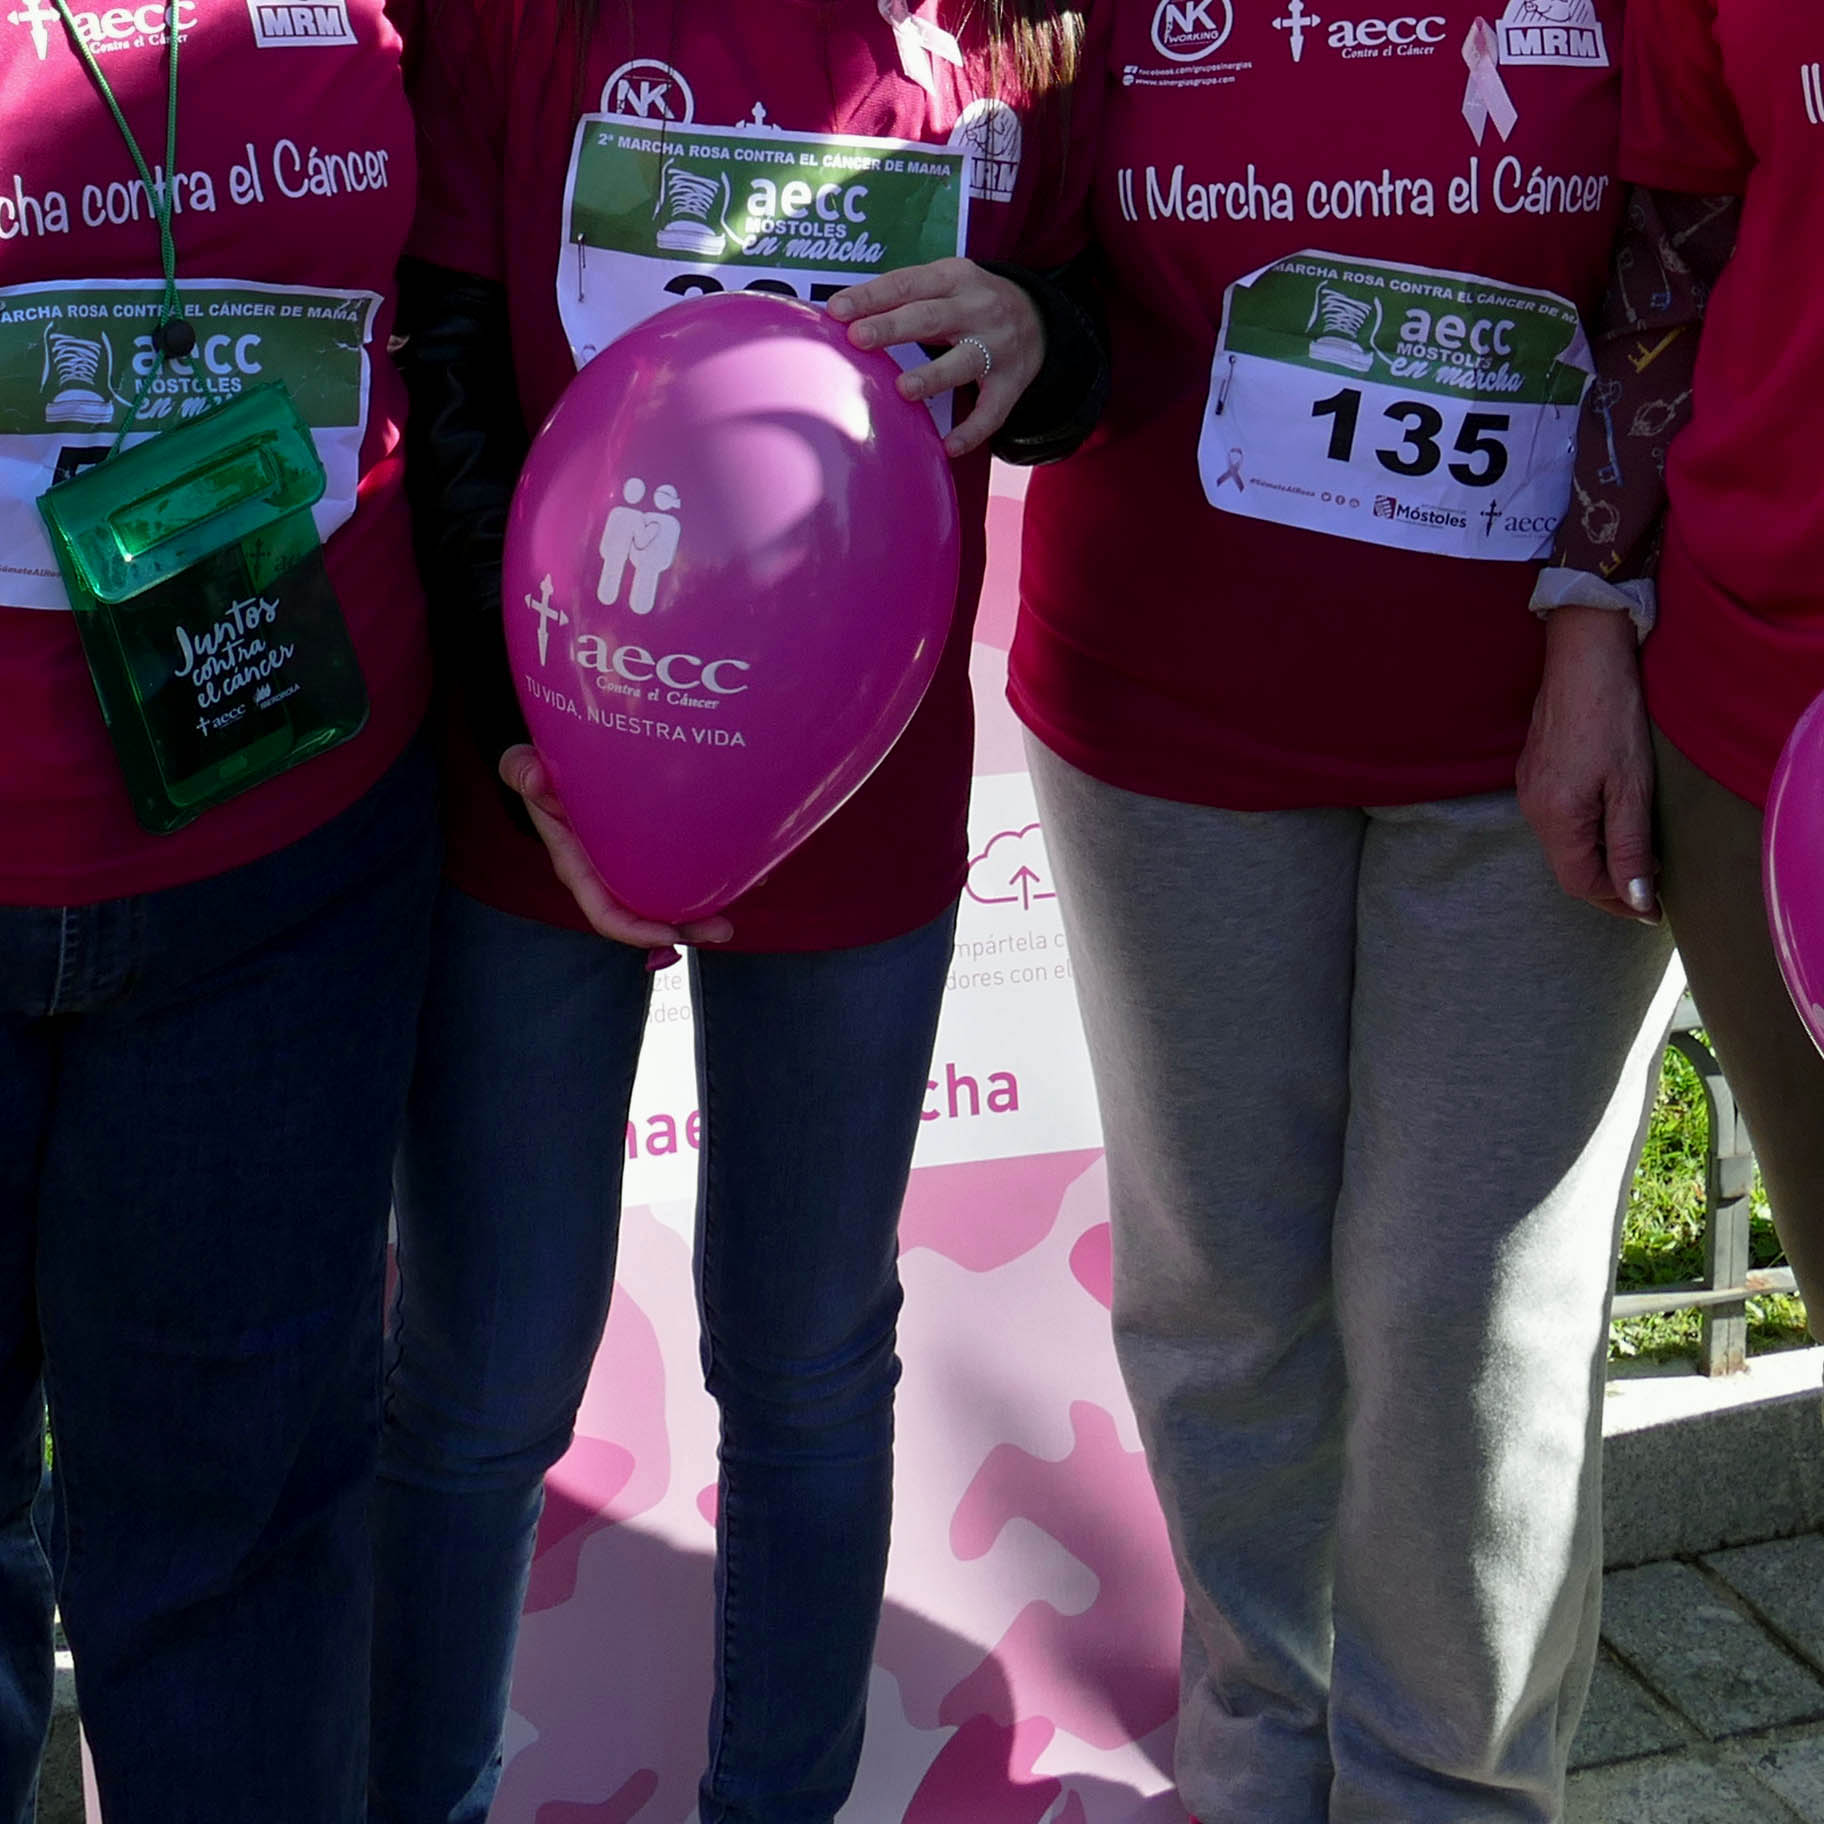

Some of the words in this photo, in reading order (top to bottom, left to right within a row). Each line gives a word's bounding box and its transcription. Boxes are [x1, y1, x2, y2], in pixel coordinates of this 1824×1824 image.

[73, 0, 199, 43] aecc
[259, 3, 344, 39] MRM
[1327, 15, 1447, 50] aecc
[1341, 44, 1380, 60] Contra
[1382, 44, 1394, 58] el
[1396, 43, 1436, 58] Cáncer
[1508, 27, 1599, 58] MRM
[617, 136, 685, 156] MARCHA
[688, 144, 730, 161] ROSA
[733, 147, 795, 166] CONTRA
[798, 152, 819, 167] EL
[822, 151, 881, 172] CÁNCER
[883, 158, 905, 173] DE
[907, 160, 952, 177] MAMA
[81, 163, 217, 228] contra
[229, 141, 264, 206] el
[272, 137, 390, 199] Cáncer
[746, 177, 868, 223] aecc
[1144, 162, 1294, 223] Marcha
[1306, 168, 1435, 222] contra
[1447, 155, 1480, 215] el
[1491, 154, 1610, 214] Cáncer
[744, 214, 847, 240] MÓSTOLES
[782, 229, 887, 264] marcha
[67, 304, 109, 319] ROSA
[184, 303, 205, 318] EL
[209, 300, 276, 317] CÁNCER
[279, 304, 304, 318] DE
[306, 305, 359, 323] MAMA
[1342, 270, 1385, 289] ROSA
[1389, 278, 1454, 302] CONTRA
[1457, 289, 1477, 305] EL
[1477, 290, 1537, 313] CÁNCER
[1537, 302, 1560, 317] DE
[1399, 307, 1516, 356] aecc
[1434, 361, 1525, 393] marcha
[1310, 387, 1511, 488] 135
[1396, 503, 1468, 529] Móstoles
[1504, 514, 1559, 533] aecc
[174, 596, 281, 678] Juntos
[192, 637, 267, 688] contra
[197, 680, 222, 709] el
[222, 642, 296, 696] cáncer
[576, 634, 751, 696] aecc
[526, 675, 541, 699] TU
[587, 704, 687, 744] NUESTRA
[691, 727, 747, 747] VIDA
[596, 675, 641, 698] Contra
[647, 687, 660, 702] el
[666, 690, 720, 710] Cáncer
[1009, 965, 1048, 984] con
